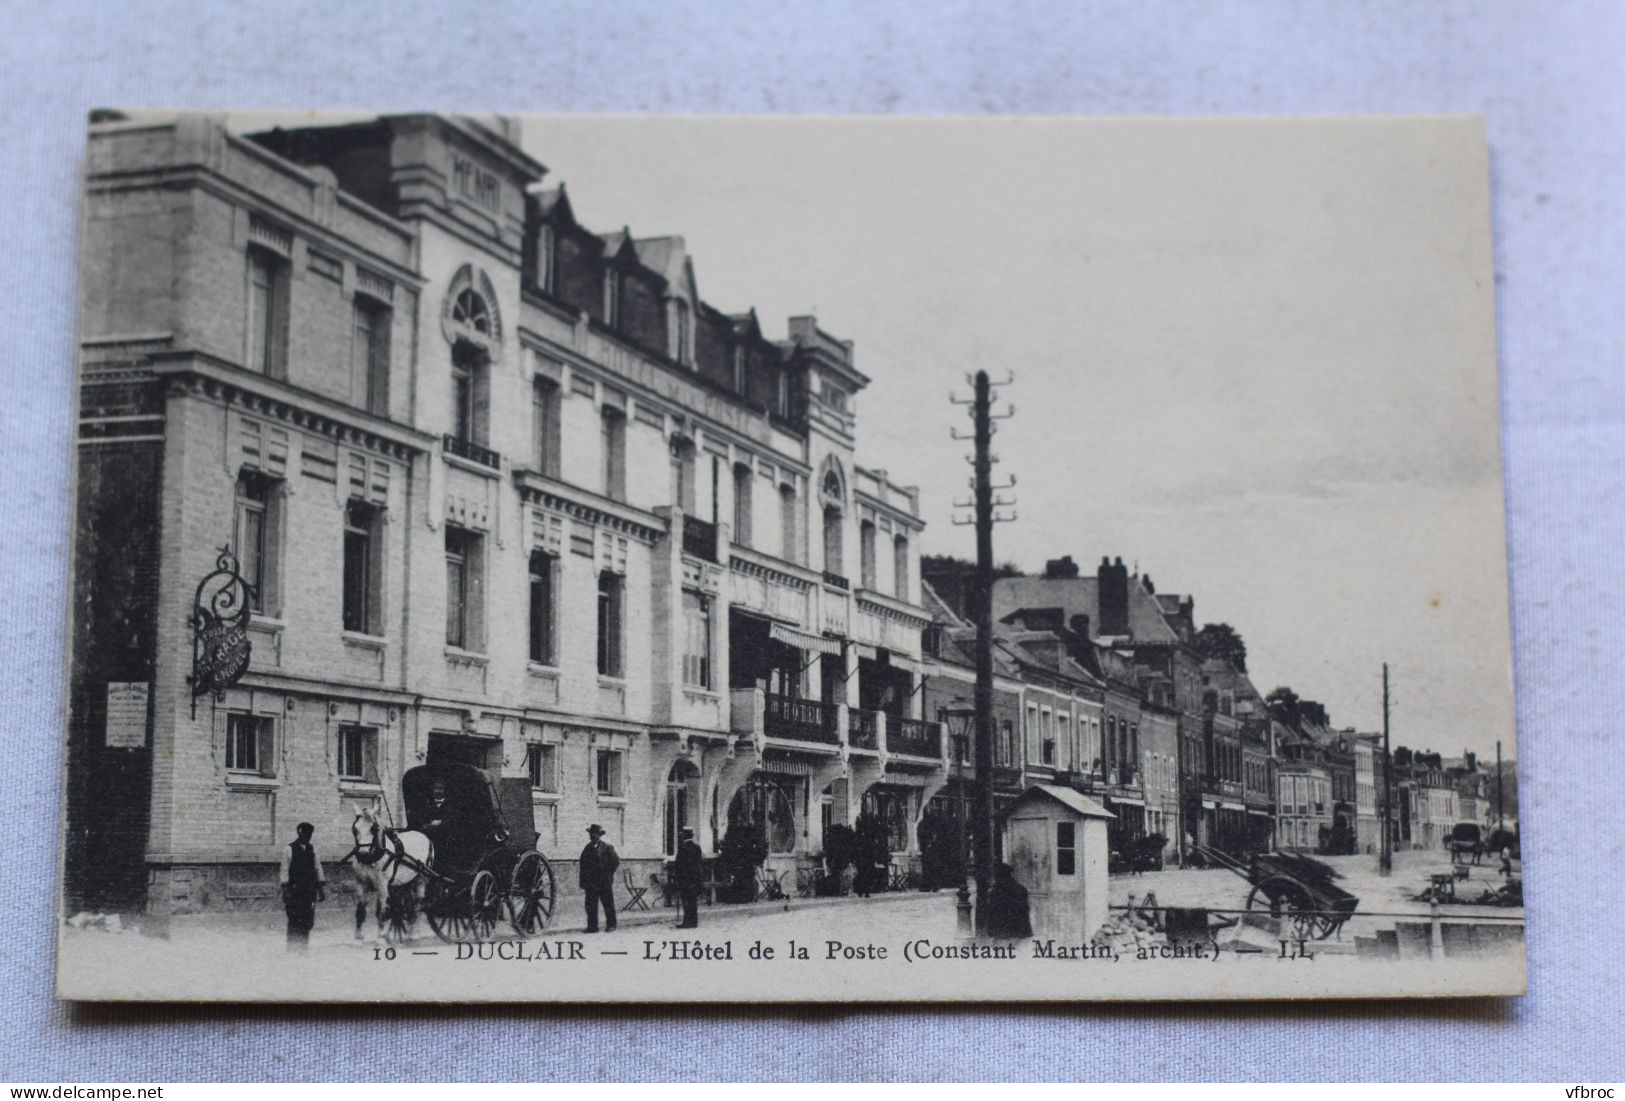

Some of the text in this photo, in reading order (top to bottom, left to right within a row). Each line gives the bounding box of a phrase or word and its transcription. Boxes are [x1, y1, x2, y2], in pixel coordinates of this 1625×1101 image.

[373, 947, 397, 961] 10
[455, 940, 587, 962] DUCLAIR
[642, 940, 733, 962] L'Hôtel
[748, 940, 775, 960] de
[788, 940, 810, 960] la
[825, 940, 889, 960] Poste
[903, 939, 1017, 963] (Constant
[1031, 939, 1120, 963] Martin,
[1136, 939, 1220, 962] archit.)
[1278, 939, 1314, 960] LL
